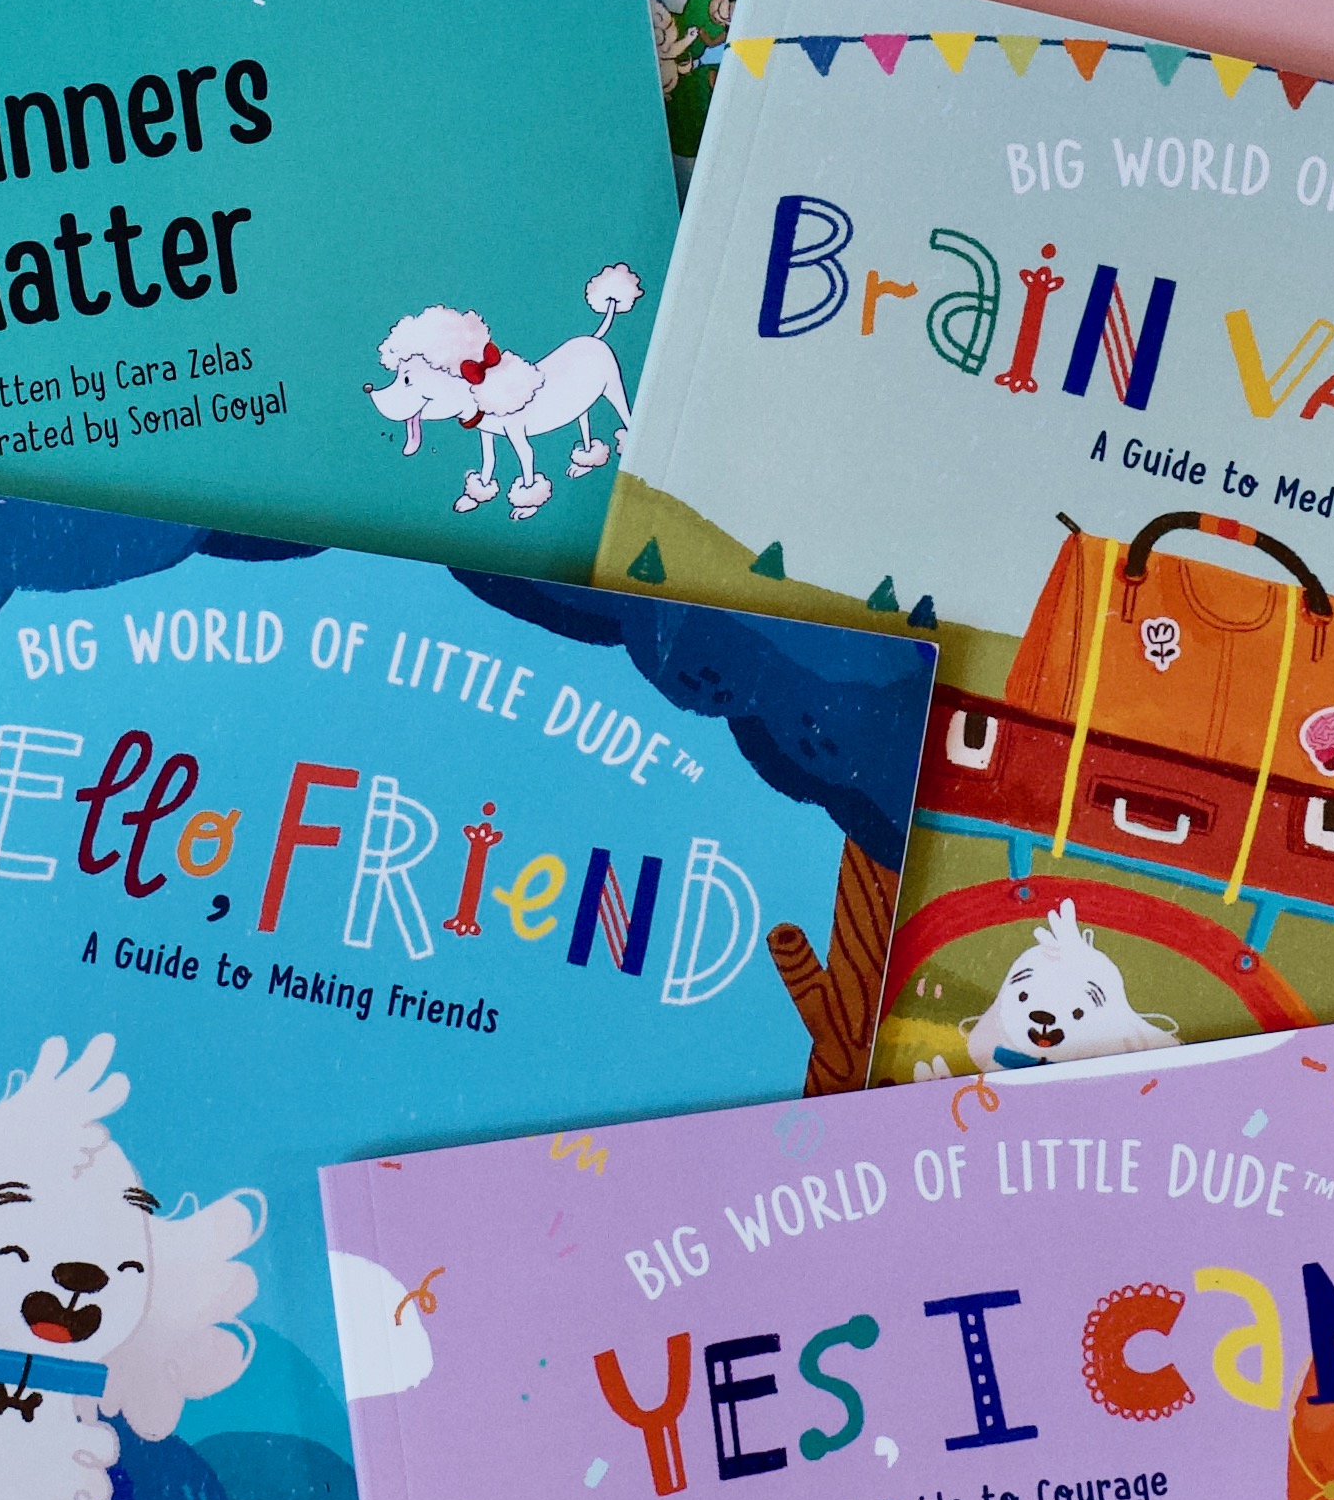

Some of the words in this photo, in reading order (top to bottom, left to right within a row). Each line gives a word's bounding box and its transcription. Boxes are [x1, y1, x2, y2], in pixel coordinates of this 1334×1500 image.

[1007, 140, 1083, 194] BIG
[1114, 138, 1269, 195] WORLD
[70, 365, 105, 401] by
[116, 360, 177, 389] Cara
[188, 343, 252, 379] Zelas
[83, 412, 119, 448] by
[128, 395, 201, 435] Sonal
[212, 381, 287, 425] Goyal
[1090, 431, 1107, 461] A
[1123, 439, 1206, 484] Guide
[1223, 461, 1258, 497] to
[18, 619, 97, 680] BIG
[124, 608, 283, 664] WORLD
[311, 617, 368, 673] OF
[387, 632, 534, 720] LITTLE
[82, 931, 97, 964] A
[115, 937, 199, 980] Guide
[217, 953, 252, 989] to
[269, 964, 373, 1020] Making
[388, 984, 498, 1033] Friends
[625, 1226, 709, 1300] BIG
[725, 1162, 887, 1252] WORLD
[914, 1144, 966, 1201] OF
[998, 1138, 1141, 1194] LITTLE
[924, 1290, 1038, 1451] I
